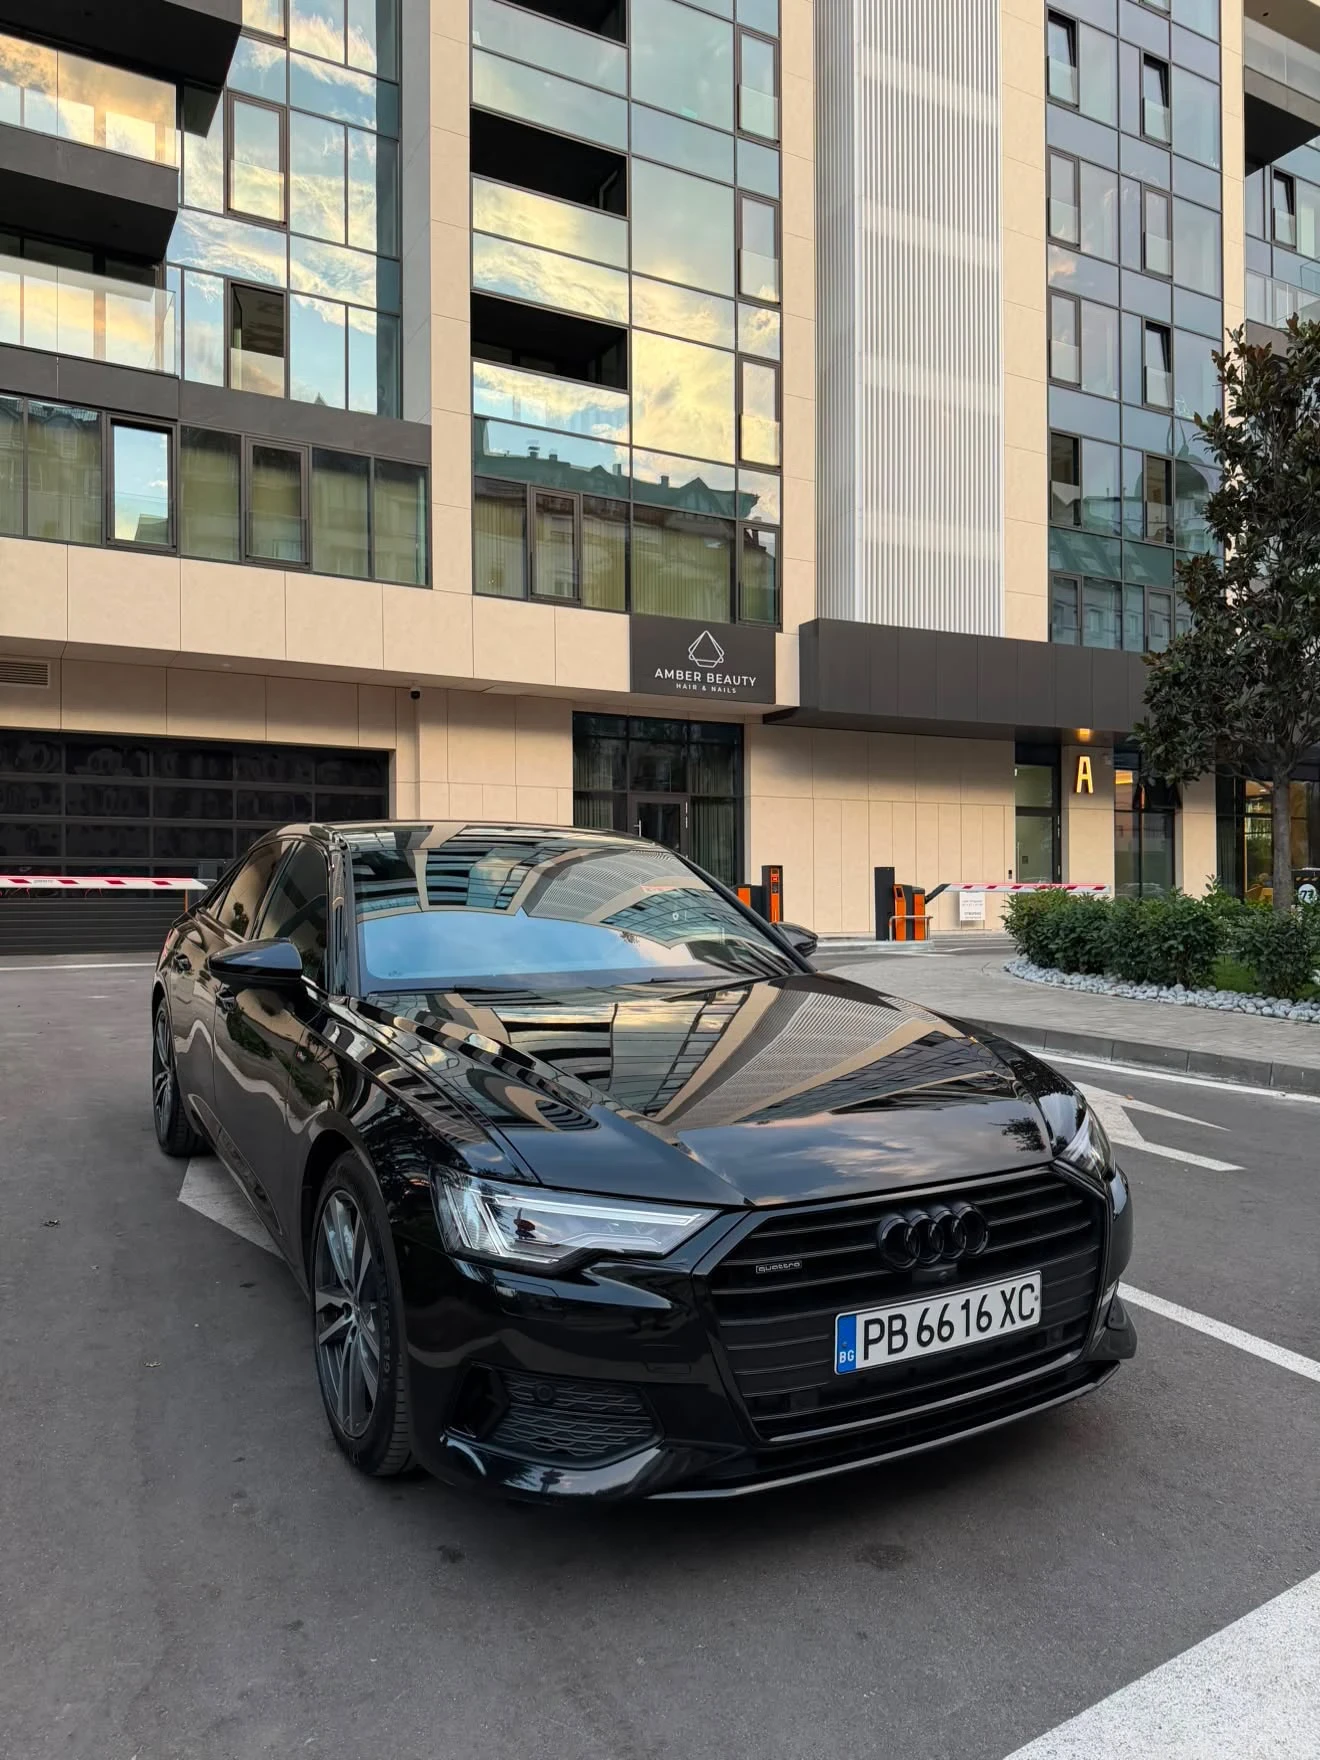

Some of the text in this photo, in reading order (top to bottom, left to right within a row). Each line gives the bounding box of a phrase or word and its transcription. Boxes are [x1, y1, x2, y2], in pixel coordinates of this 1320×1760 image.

[654, 667, 757, 687] AMBER BEAUTY
[711, 686, 737, 694] NAILS
[1075, 756, 1094, 794] A
[758, 1262, 801, 1273] quattro
[863, 1282, 1035, 1361] PB 6616 XC
[839, 1350, 855, 1364] BG
